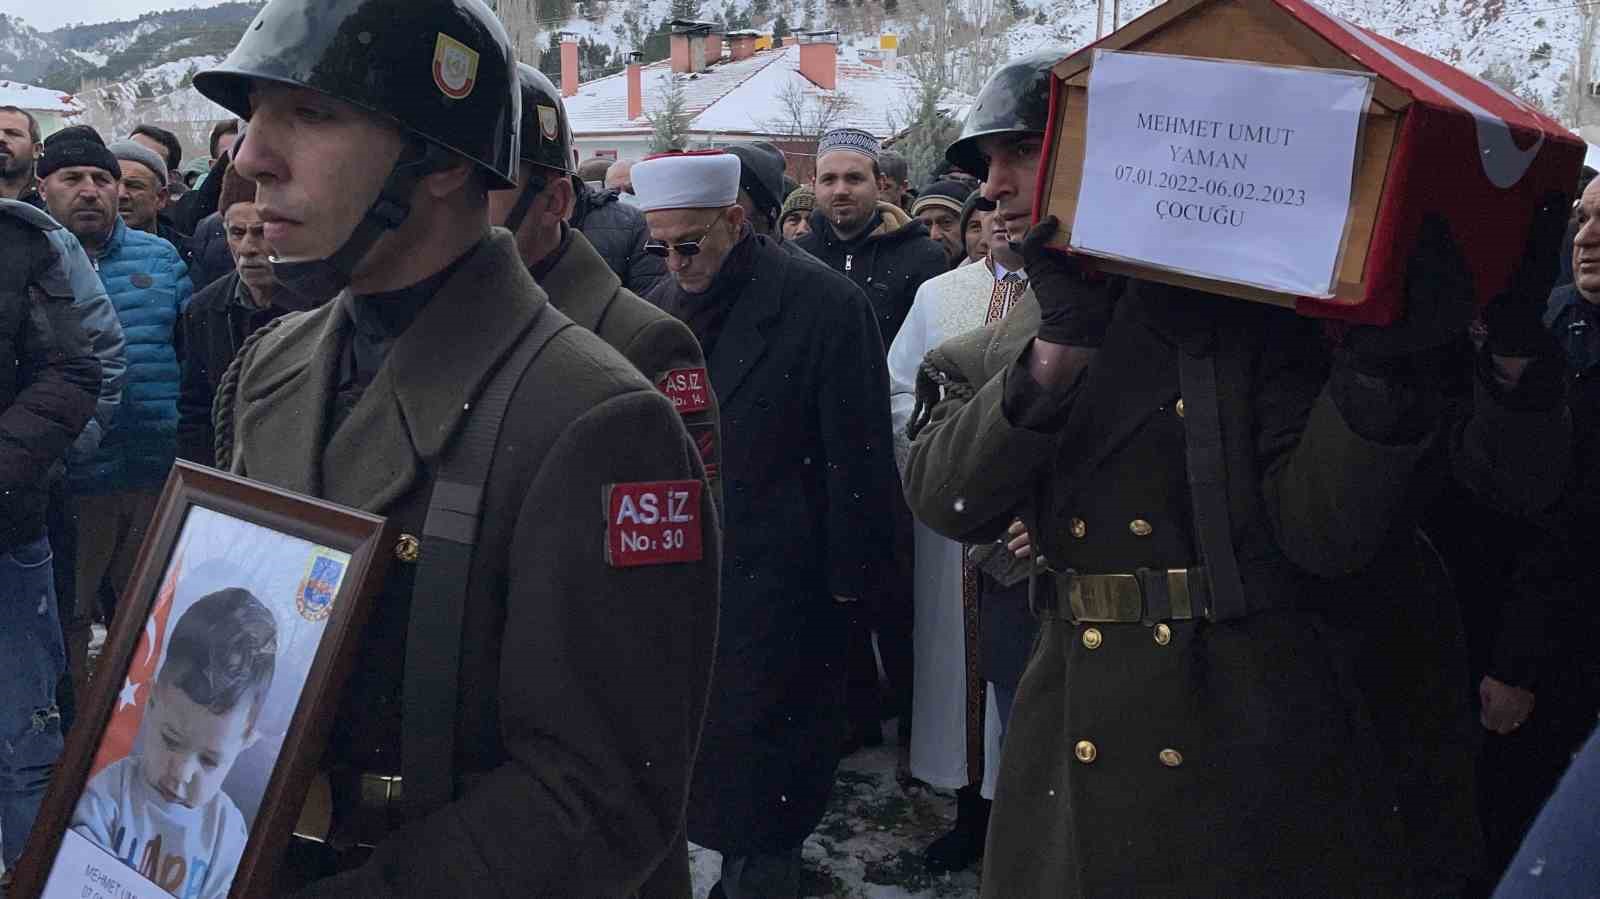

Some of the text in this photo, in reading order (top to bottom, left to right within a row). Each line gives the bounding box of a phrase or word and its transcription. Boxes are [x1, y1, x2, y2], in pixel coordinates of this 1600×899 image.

[1137, 112, 1295, 146] MEHMET UMUT
[1169, 144, 1249, 171] YAMAN
[1114, 164, 1306, 206] 07.01.2022-06.02.2023
[1155, 199, 1244, 227] ÇOCUĞU
[620, 529, 684, 552] No: 30
[85, 863, 121, 895] MEHMET
